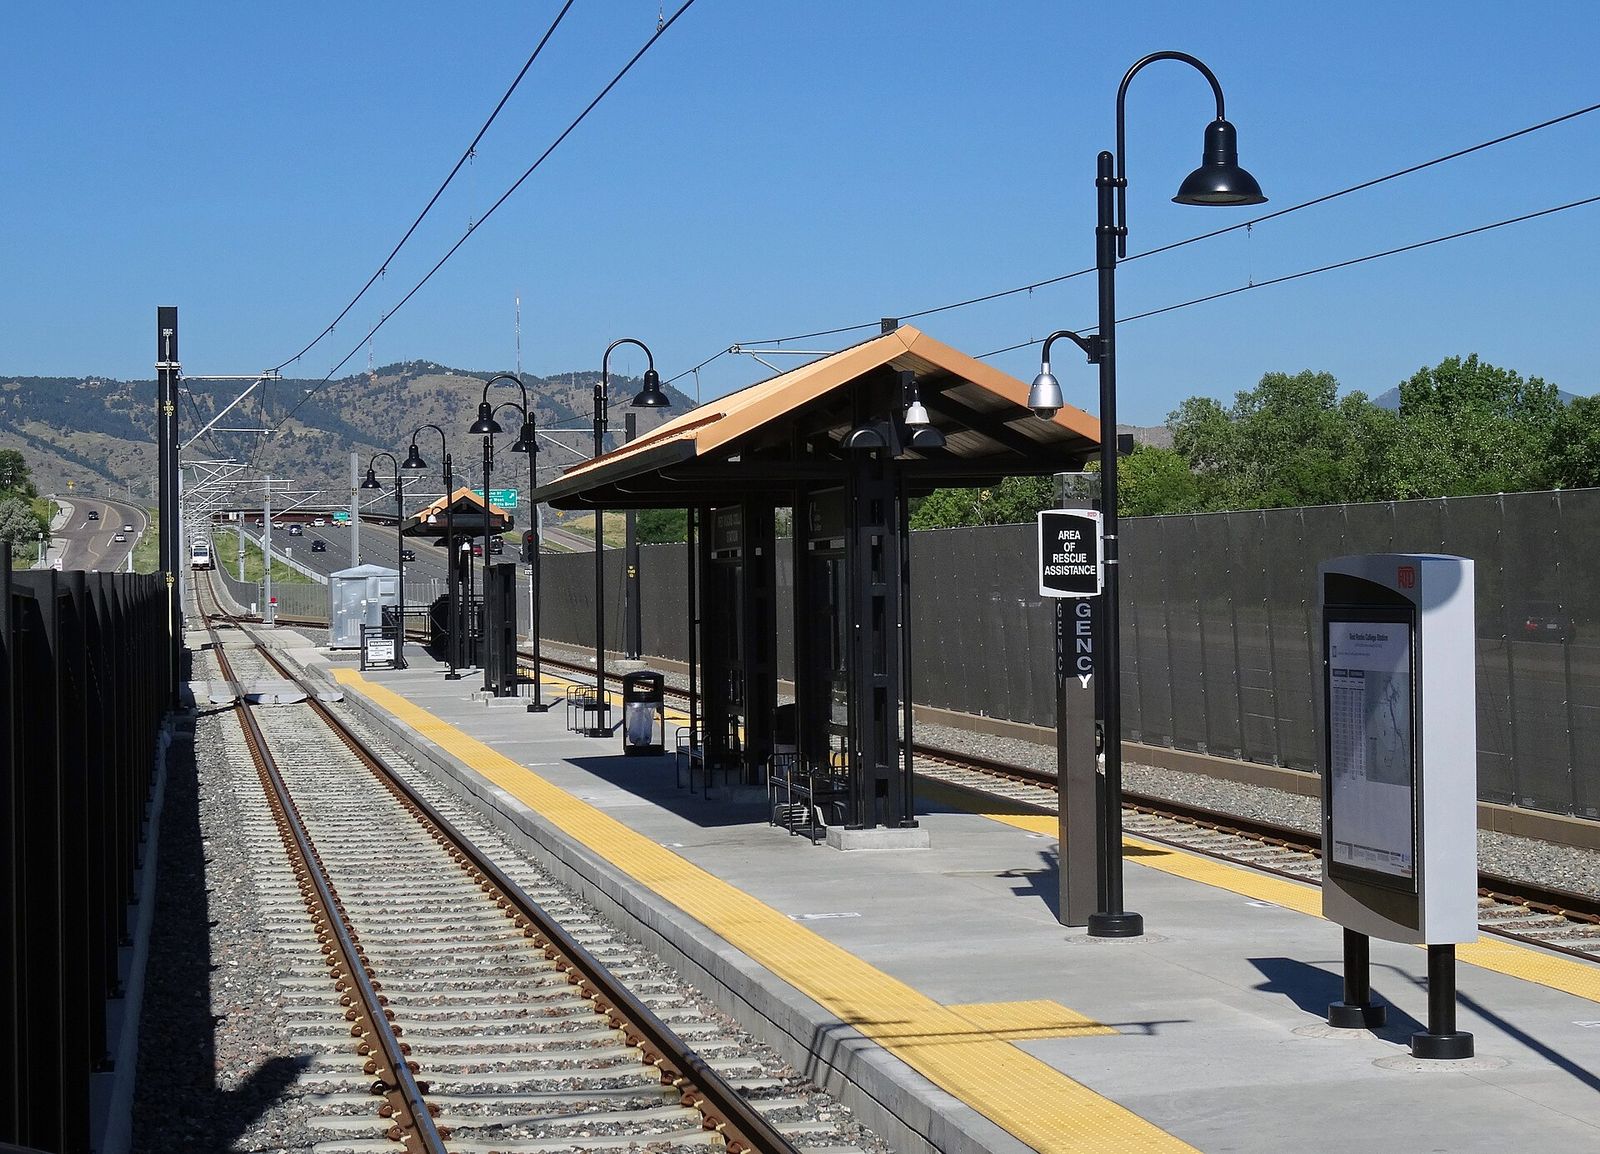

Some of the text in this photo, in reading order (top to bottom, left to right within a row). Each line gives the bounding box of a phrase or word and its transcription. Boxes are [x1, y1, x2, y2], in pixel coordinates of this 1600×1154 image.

[1058, 530, 1081, 540] AREA
[1063, 542, 1076, 552] OF
[1052, 553, 1087, 564] RESCUE
[1044, 565, 1096, 576] ASSISTANCE
[1075, 597, 1093, 689] GENCY
